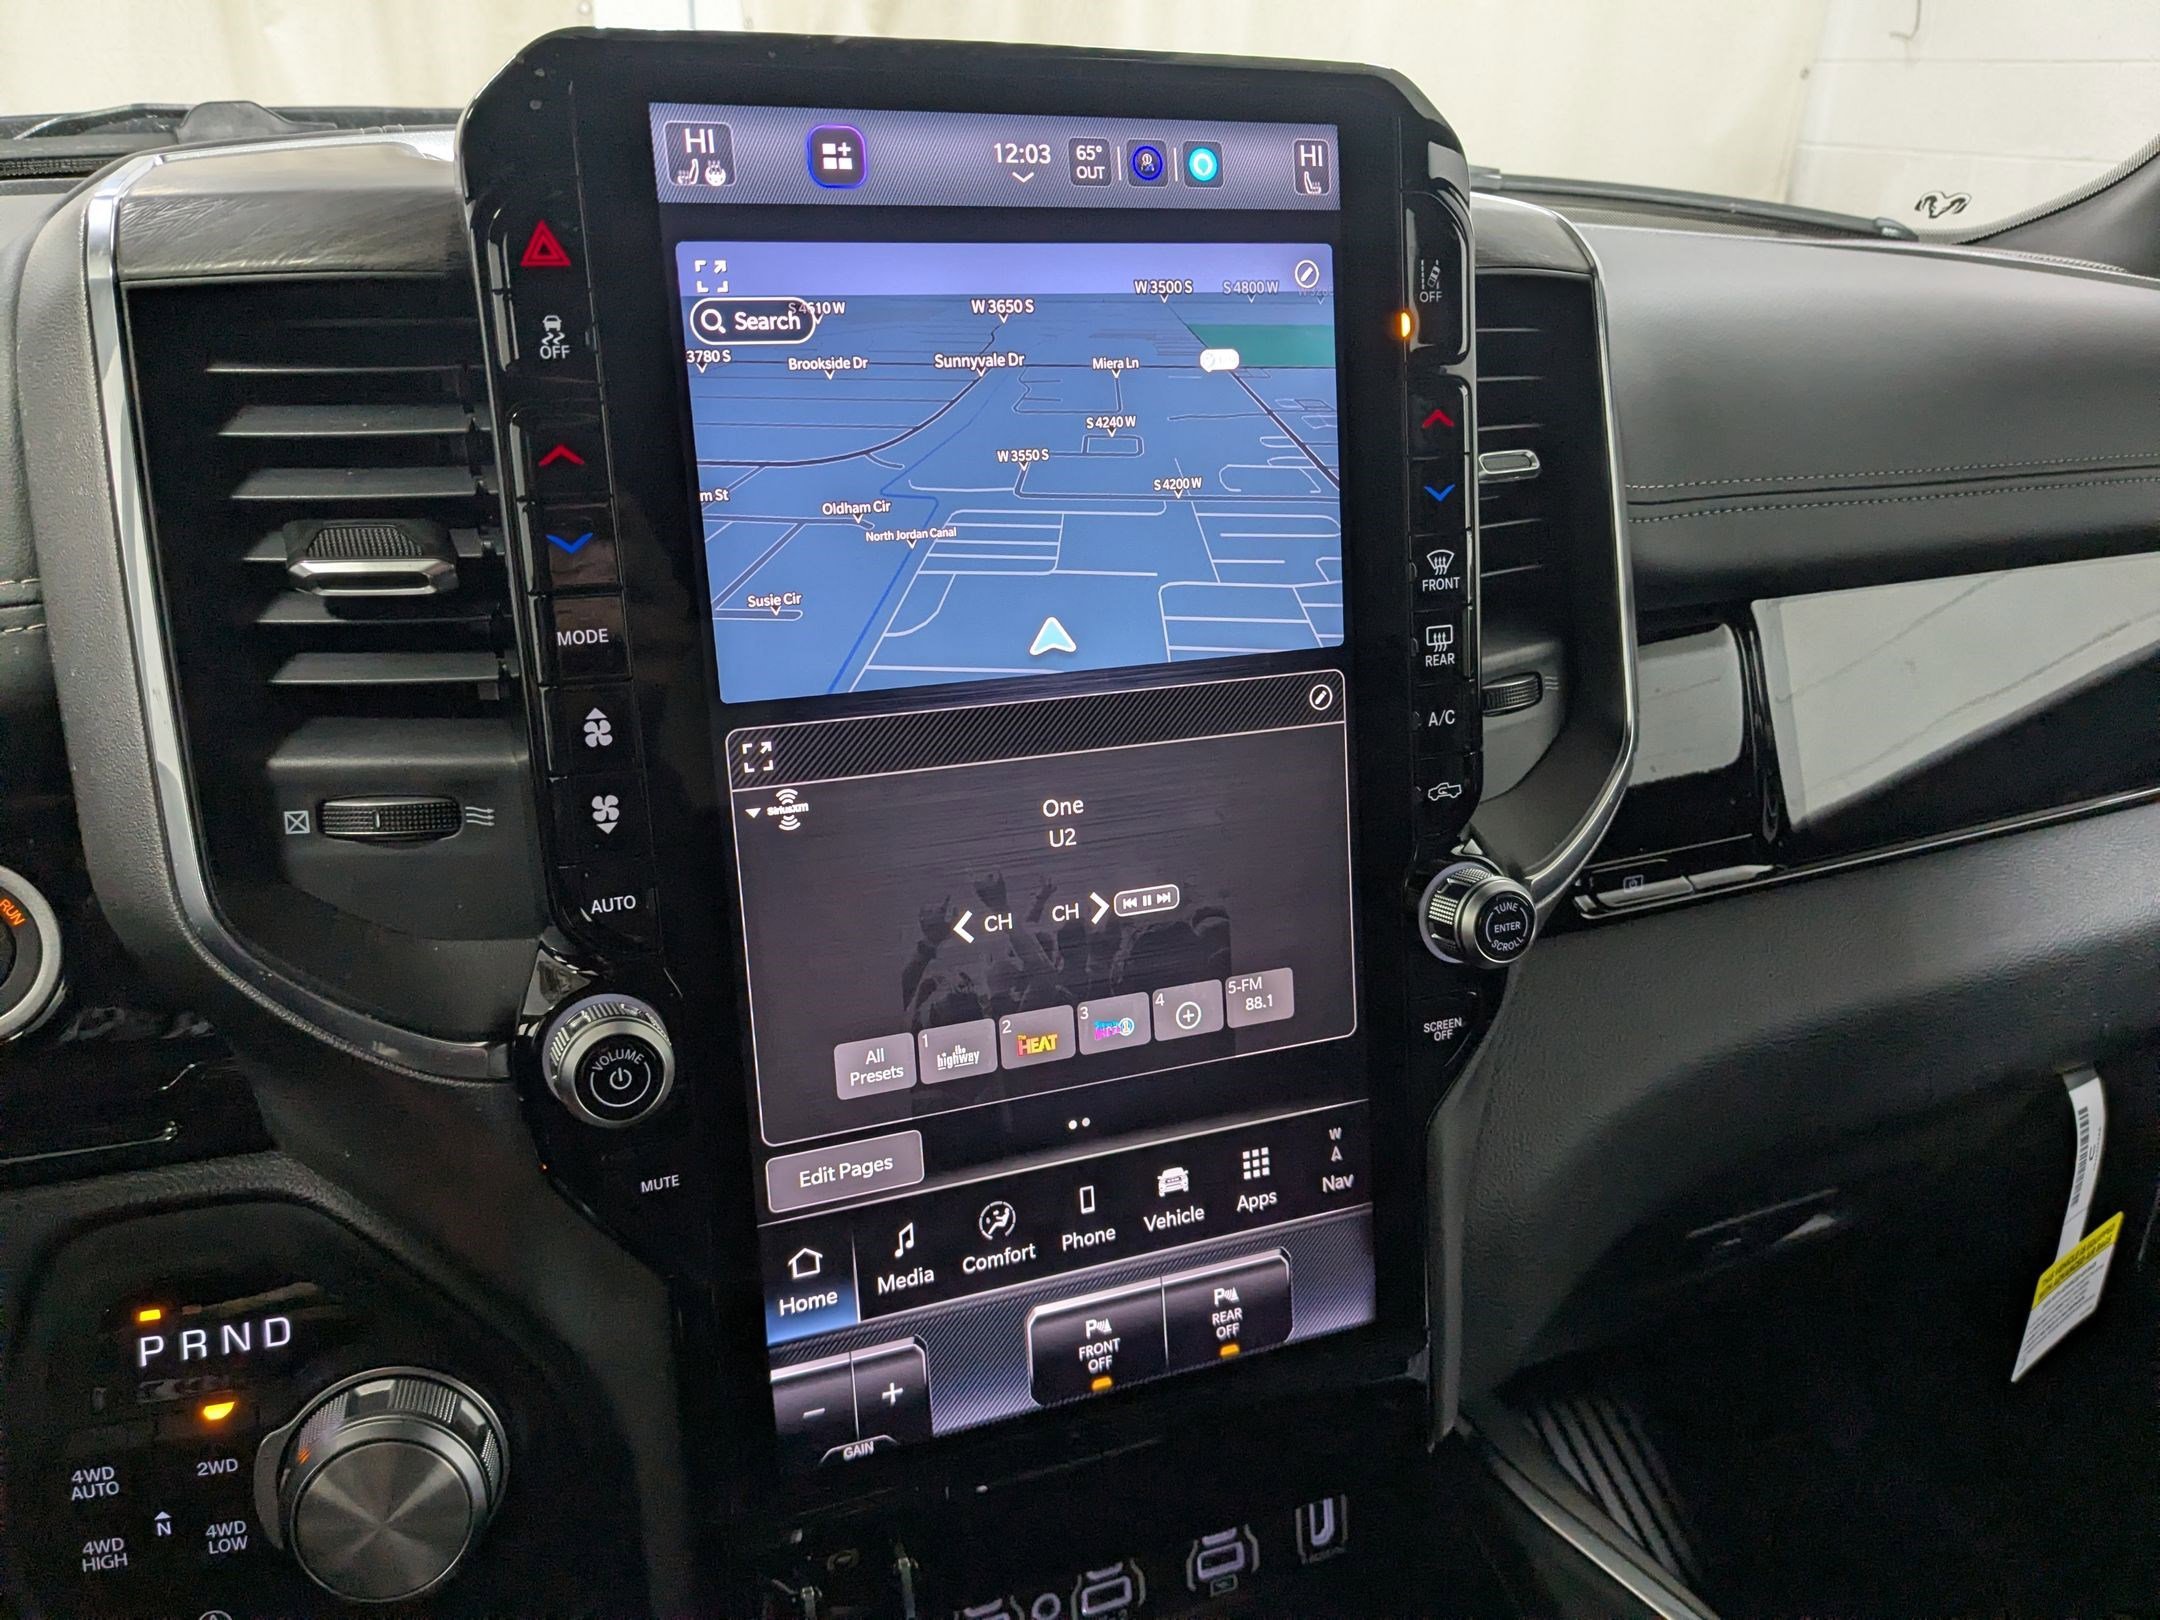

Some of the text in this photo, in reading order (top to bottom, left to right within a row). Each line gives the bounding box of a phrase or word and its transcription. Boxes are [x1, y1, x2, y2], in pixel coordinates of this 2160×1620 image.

[684, 128, 715, 153] HI
[994, 142, 1052, 164] 12:03
[1299, 145, 1324, 167] HI
[1076, 165, 1105, 180] OUT
[1134, 280, 1193, 295] W 3500 S
[1223, 281, 1279, 294] S 4800 W
[1419, 290, 1443, 303] OFF
[832, 301, 846, 314] W
[971, 299, 1034, 314] W 3650 S
[734, 309, 801, 331] Search
[539, 344, 571, 360] OFF
[686, 349, 732, 363] 3780 S
[788, 356, 869, 371] Brookside Dr
[934, 352, 1025, 371] Sunnyvale Dr
[1092, 357, 1140, 370] Miera Ln
[1086, 416, 1136, 428] S 4240 W
[997, 448, 1050, 462] W 3550 S
[1153, 477, 1202, 490] S 4200 W
[714, 488, 730, 501] St
[822, 500, 891, 515] Oldham Cir
[865, 527, 957, 542] North Jordan Canal
[1422, 576, 1460, 592] FRONT
[747, 593, 802, 608] Susie Cir
[556, 628, 609, 646] MODE
[1425, 651, 1456, 668] REAR
[1428, 709, 1456, 727] A/C
[1042, 799, 1084, 818] One
[1049, 828, 1077, 848] U2
[0, 898, 26, 926] RUN
[590, 895, 637, 914] AUTO
[1052, 902, 1080, 921] CH
[1494, 902, 1519, 914] TUNE
[984, 912, 1013, 932] CH
[1494, 921, 1521, 934] ENTER
[1491, 935, 1524, 952] SCROLL
[1228, 976, 1262, 994] 5-FM
[1155, 993, 1165, 1006] 4
[1245, 994, 1273, 1011] 88.1
[1080, 1006, 1089, 1020] 3
[1002, 1020, 1012, 1034] 2
[1423, 1017, 1462, 1033] SCREEN
[921, 1033, 929, 1048] 1
[1433, 1029, 1453, 1042] OFF
[1017, 1034, 1058, 1057] HEAT
[591, 1048, 646, 1073] VOLUME
[865, 1047, 885, 1065] All
[936, 1050, 980, 1070] highway
[850, 1065, 904, 1087] Presets
[800, 1157, 894, 1188] Edit Pages
[640, 1174, 681, 1194] MUTE
[1322, 1173, 1354, 1193] Nav
[1236, 1190, 1278, 1214] Apps
[1143, 1205, 1205, 1232] Vehicle
[1062, 1226, 1117, 1252] Phone
[962, 1242, 1037, 1274] Comfort
[877, 1266, 935, 1296] Media
[778, 1289, 838, 1317] Home
[1211, 1307, 1243, 1326] REAR
[1215, 1322, 1240, 1339] OFF
[1078, 1337, 1121, 1361] FRONT
[1087, 1355, 1113, 1374] OFF
[843, 1441, 875, 1462] GAIN
[71, 1466, 115, 1484] 4WD
[197, 1458, 239, 1477] 2WD
[70, 1481, 120, 1501] AUTO
[156, 1521, 173, 1537] N
[205, 1520, 247, 1539] 4WD
[82, 1537, 125, 1556] 4WD
[207, 1535, 249, 1556] LOW
[81, 1552, 128, 1574] HIGH
